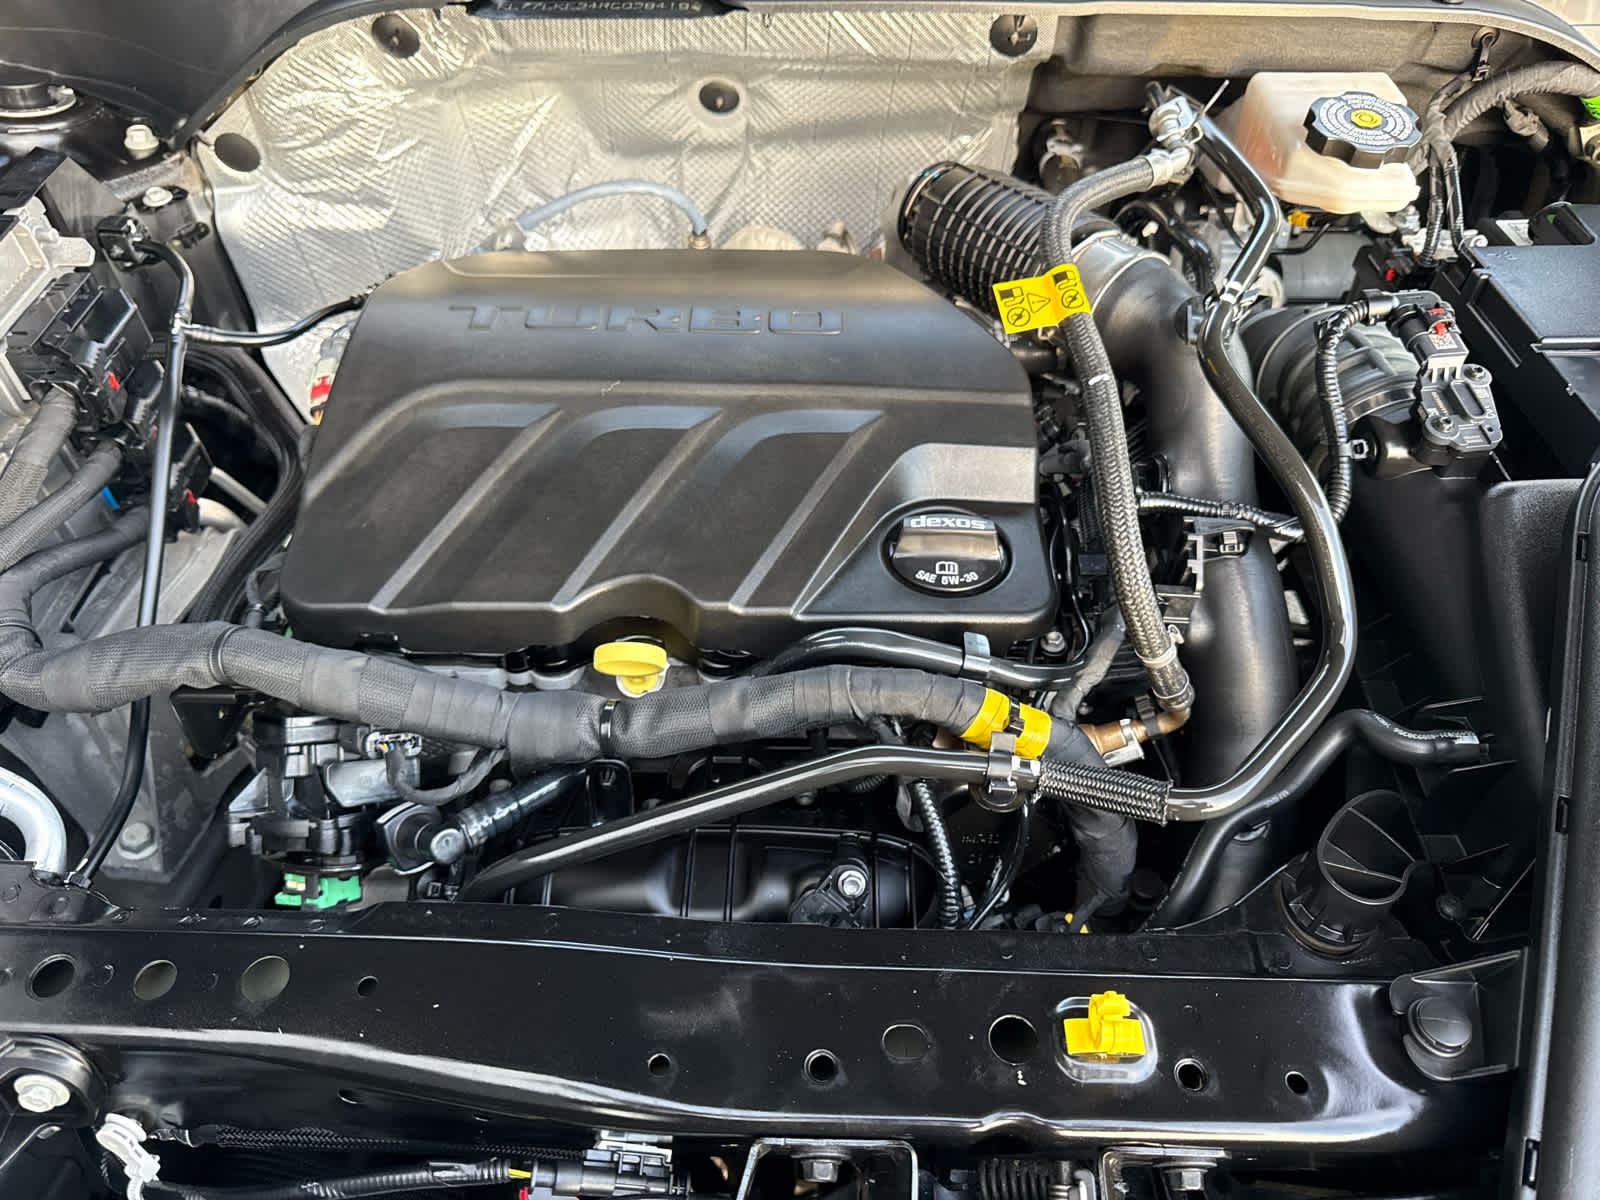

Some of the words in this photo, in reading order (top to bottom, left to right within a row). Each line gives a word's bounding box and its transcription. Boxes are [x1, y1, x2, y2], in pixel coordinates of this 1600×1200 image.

[448, 304, 843, 336] TURBO
[910, 515, 987, 529] dexos
[915, 569, 937, 584] SAE
[941, 571, 979, 586] 5W-30
